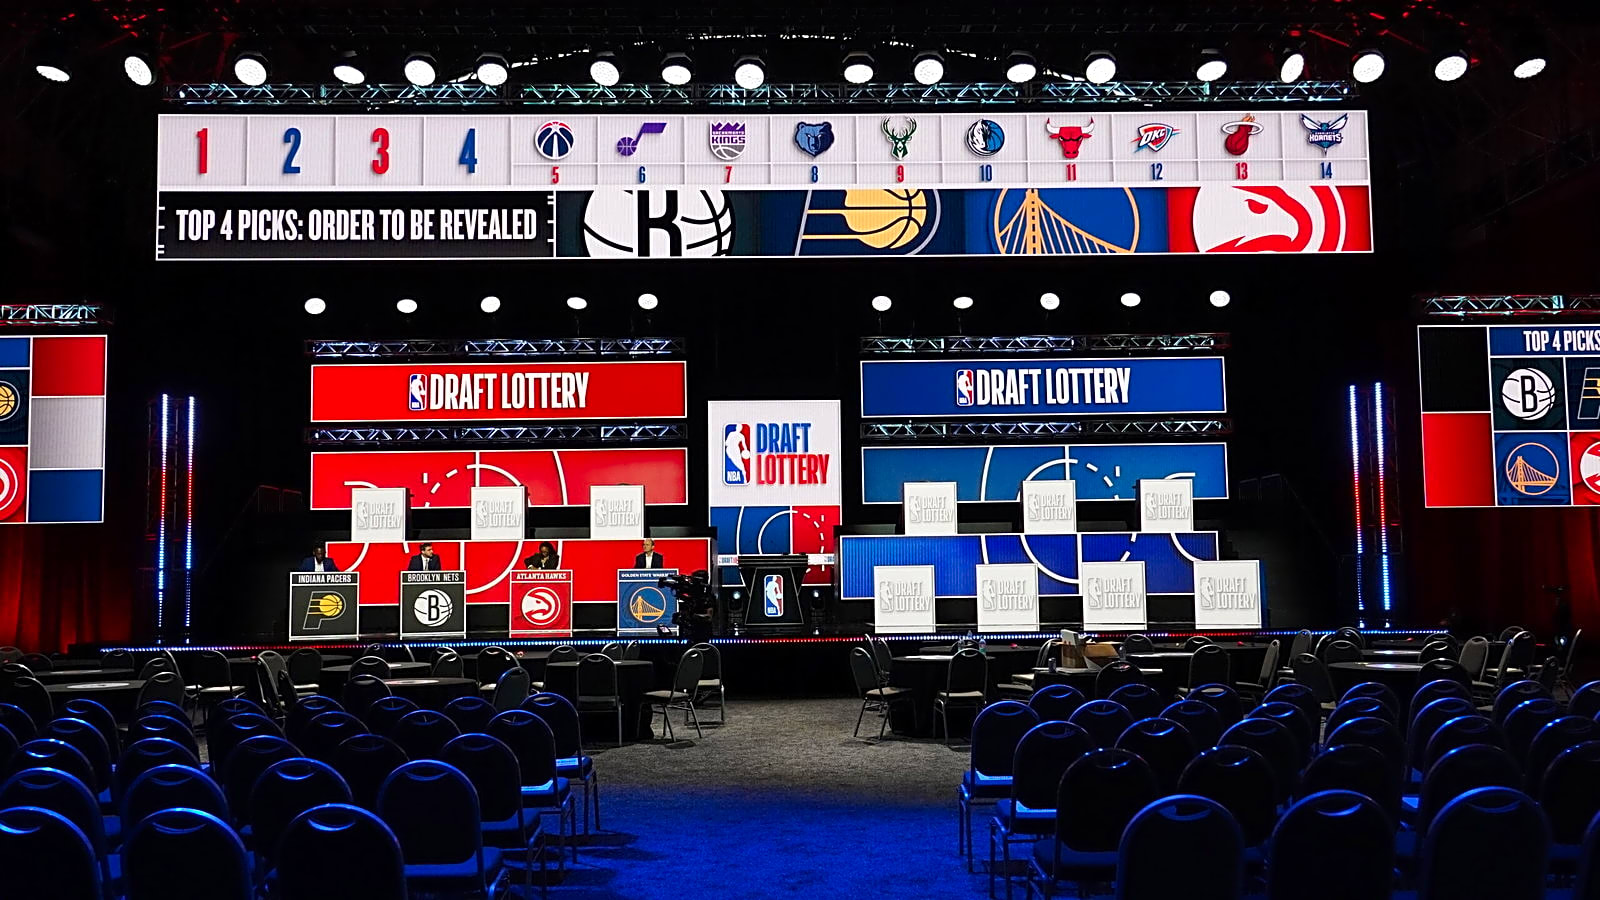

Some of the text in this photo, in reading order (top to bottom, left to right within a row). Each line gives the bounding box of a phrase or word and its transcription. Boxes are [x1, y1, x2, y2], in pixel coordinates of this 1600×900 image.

[711, 136, 746, 144] KINGS
[1141, 128, 1166, 144] OKC
[1309, 133, 1342, 142] HORNETS
[196, 128, 208, 174] 1
[283, 128, 301, 174] 2
[371, 128, 390, 174] 3
[459, 128, 478, 173] 4
[552, 166, 560, 183] 5
[639, 166, 646, 183] 6
[725, 166, 733, 183] 7
[811, 165, 819, 182] 8
[896, 165, 904, 182] 9
[979, 165, 992, 182] 10
[1066, 164, 1077, 181] 11
[1151, 163, 1163, 180] 12
[1235, 163, 1248, 180] 13
[1320, 163, 1332, 179] 14
[176, 209, 537, 241] TOP 4 PICKS: ORDER TO BE REVEALED
[1523, 330, 1600, 352] TOP 4 PICKS
[429, 372, 589, 409] DRAFT LOTTERY
[976, 367, 1131, 405] DRAFT LOTTERY
[756, 423, 811, 453] DRAFT
[727, 471, 741, 482] NBA
[756, 454, 829, 485] LOTTERY
[489, 500, 514, 514] DRAFT
[609, 499, 633, 512] DRAFT
[922, 496, 947, 509] DRAFT
[1040, 494, 1065, 507] DRAFT
[1159, 493, 1182, 506] DRAFT
[369, 501, 395, 515] DRAFT
[922, 509, 953, 522] LOTTERY
[1041, 507, 1072, 521] LOTTERY
[1159, 506, 1190, 520] LOTTERY
[370, 515, 401, 529] LOTTERY
[489, 514, 521, 528] LOTTERY
[609, 512, 640, 526] LOTTERY
[298, 574, 352, 583] INDIANA PACERS
[407, 573, 460, 582] BROOKLYN NETS
[516, 572, 567, 580] ATLANTA HAWKS
[895, 581, 922, 595] DRAFT
[999, 580, 1025, 594] DRAFT
[1103, 578, 1132, 592] DRAFT
[1217, 577, 1245, 592] DRAFT
[427, 594, 440, 621] B
[895, 595, 931, 611] LOTTERY
[999, 594, 1034, 611] LOTTERY
[1104, 592, 1142, 608] LOTTERY
[1217, 593, 1256, 609] LOTTERY
